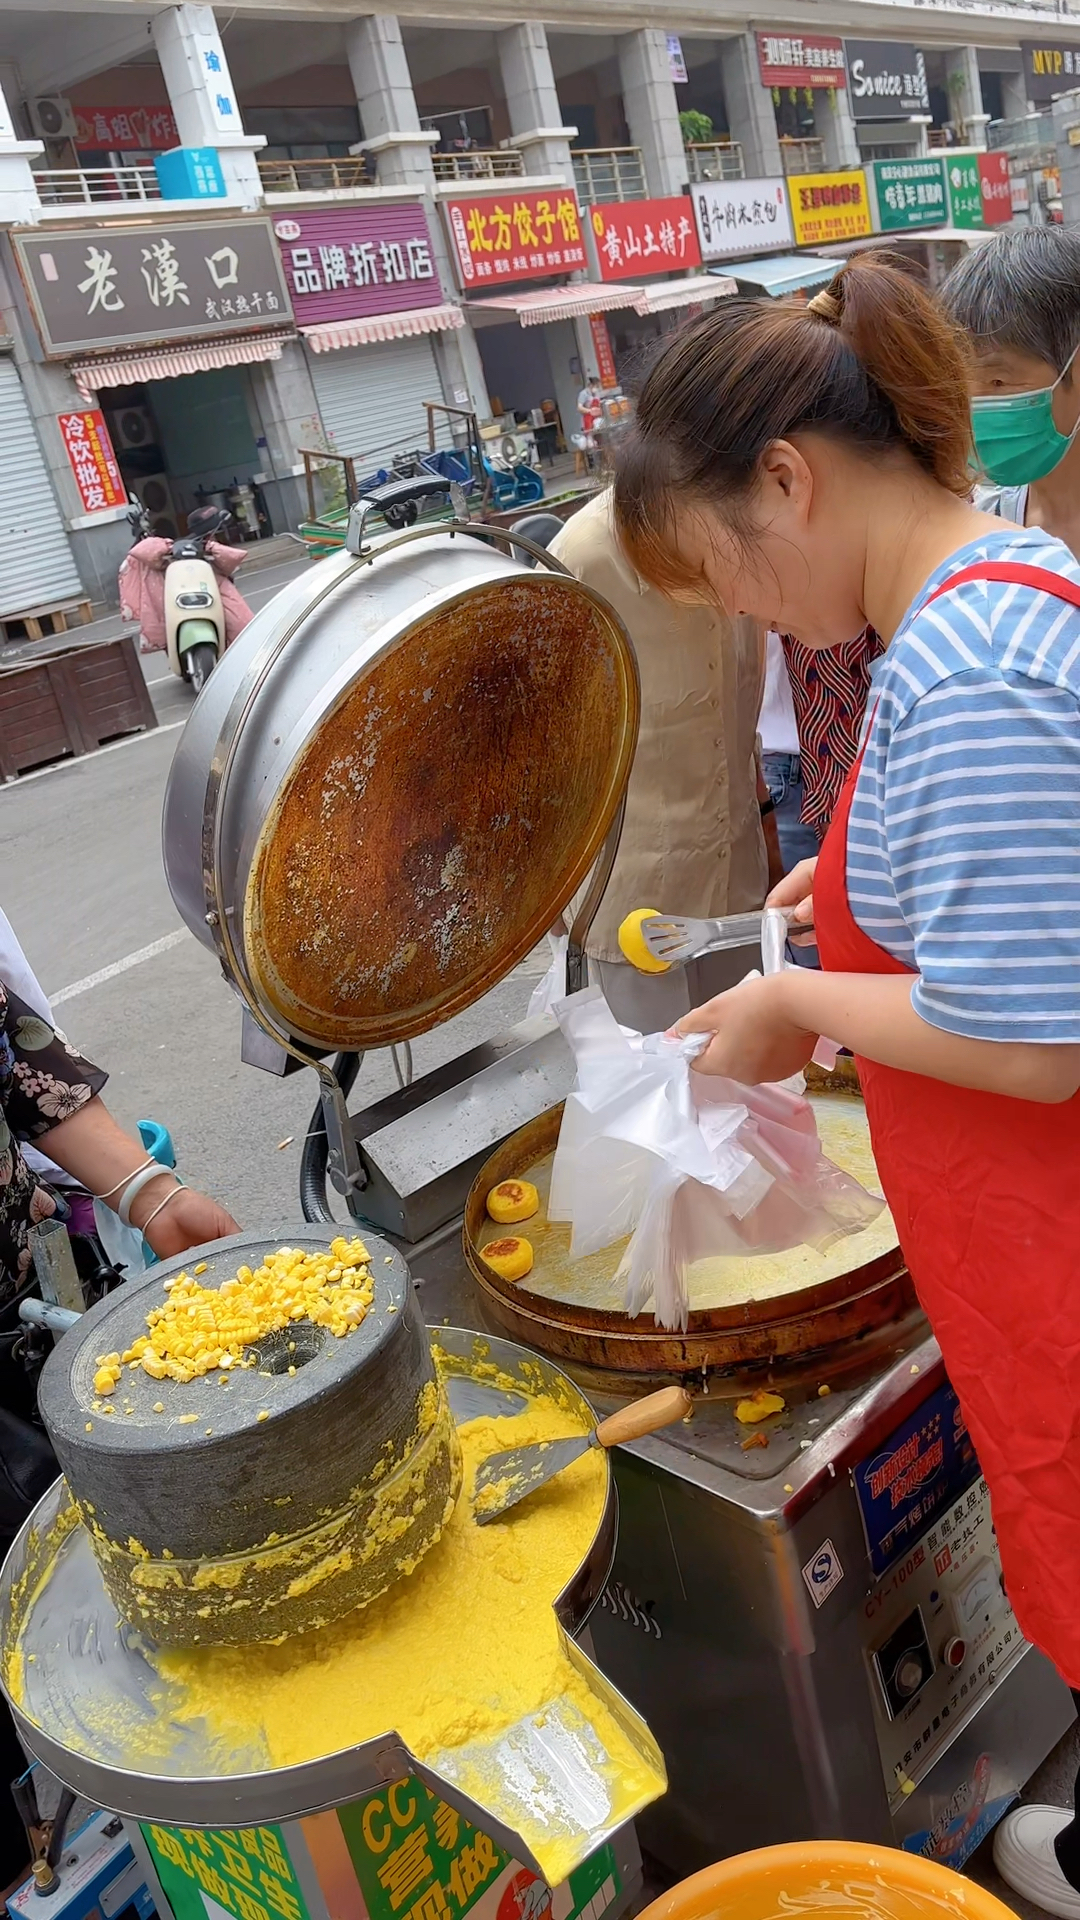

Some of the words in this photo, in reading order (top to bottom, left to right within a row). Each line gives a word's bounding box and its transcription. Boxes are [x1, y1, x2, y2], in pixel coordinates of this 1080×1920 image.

[203, 50, 233, 116] 瑜伽
[1032, 49, 1063, 75] MVP
[92, 113, 133, 143] 高姐
[152, 113, 180, 139] 炸
[466, 198, 580, 253] 北方饺子馆
[601, 215, 693, 269] 黄山土特产
[77, 238, 239, 315] 老漢口
[291, 237, 434, 294] 品牌折扣店
[204, 291, 279, 321] 武汉热干面
[61, 414, 108, 511] 冷饮批发
[865, 1544, 926, 1619] CY-100型
[362, 1778, 435, 1853] CC
